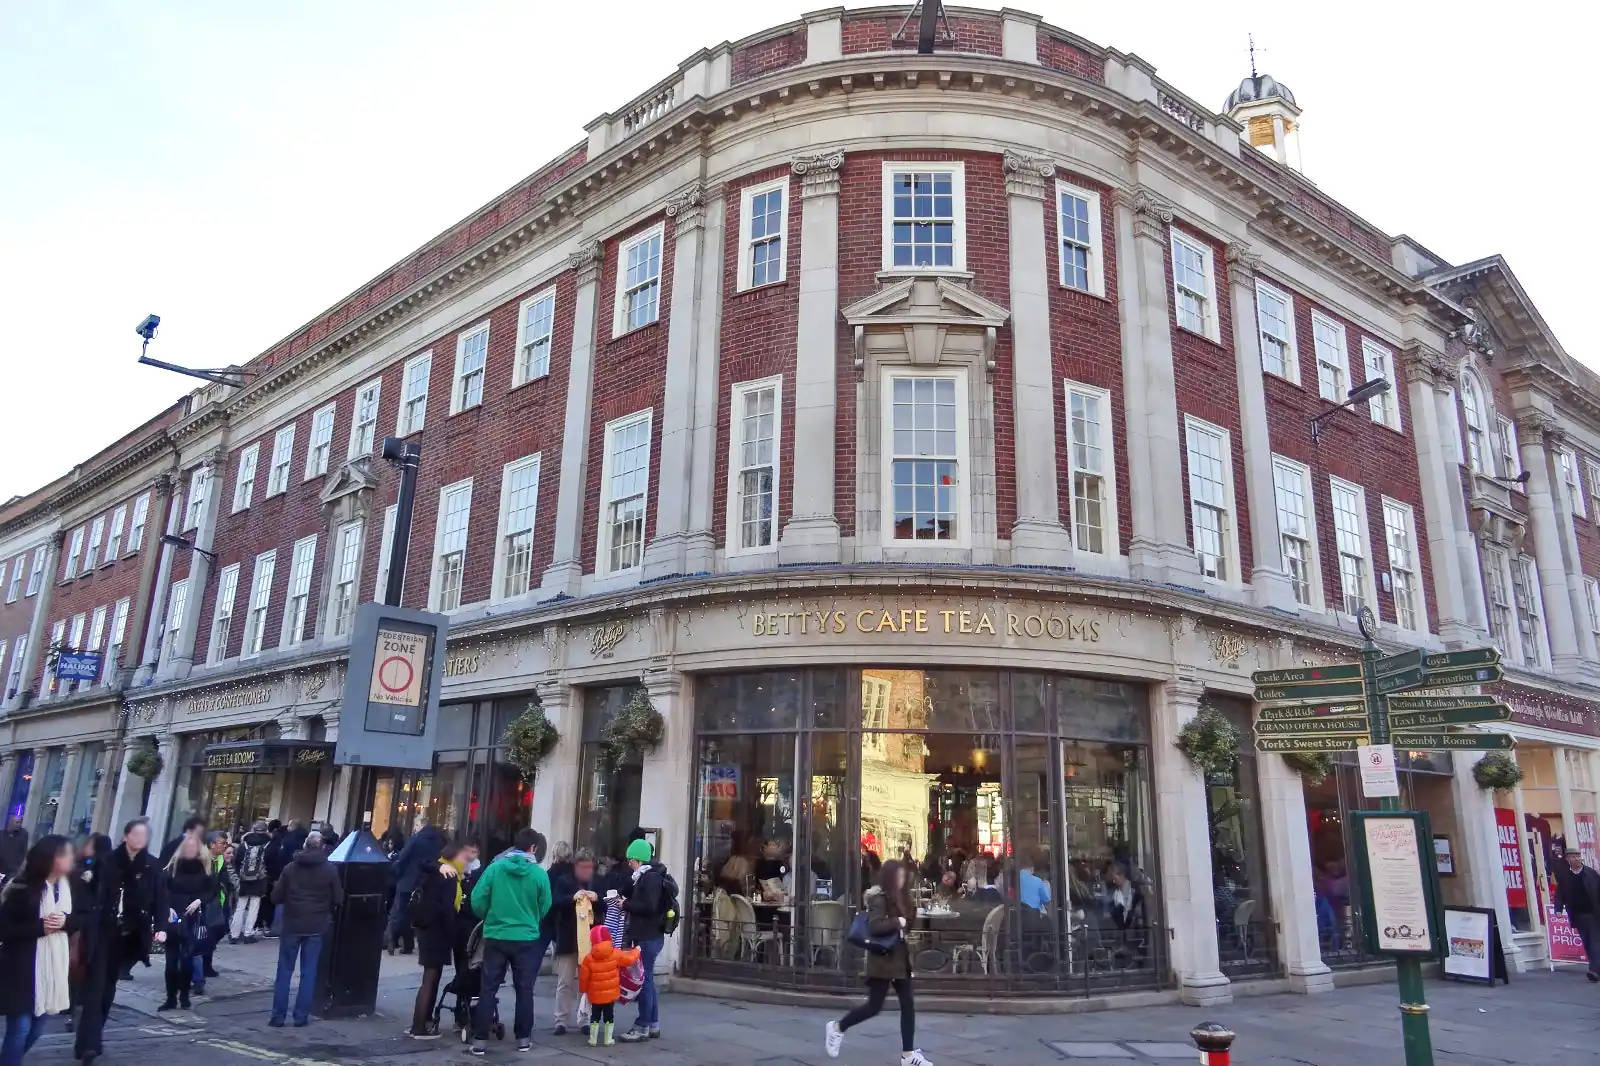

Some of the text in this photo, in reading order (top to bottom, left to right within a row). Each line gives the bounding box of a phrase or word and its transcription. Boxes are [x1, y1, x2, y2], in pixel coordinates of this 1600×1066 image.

[752, 609, 1100, 642] BETTYS CAFE TEA ROOMS
[379, 631, 424, 643] PEDESTRIAN
[383, 641, 417, 654] ZONE
[60, 662, 97, 671] HALIFAX
[1283, 672, 1305, 681] Area
[216, 689, 272, 710] CONFECTIONERS
[374, 692, 384, 700] No
[1259, 689, 1286, 699] Toilets
[1391, 698, 1424, 710] National
[1425, 698, 1456, 709] Railway
[1264, 709, 1284, 719] Park
[1285, 709, 1294, 717] &
[1394, 713, 1445, 726] Taxi Rank
[1260, 720, 1361, 731] GRAND OPERA HOUSE
[1262, 739, 1353, 749] York's Sweet Story
[1395, 735, 1477, 747] Assembly Rooms
[222, 753, 233, 765] TEA
[233, 751, 255, 764] ROOMS
[1498, 825, 1517, 845] ALE
[1501, 847, 1520, 867] ALE
[1505, 870, 1524, 889] ALE
[1553, 926, 1580, 936] HAL
[1552, 935, 1583, 946] PRIC
